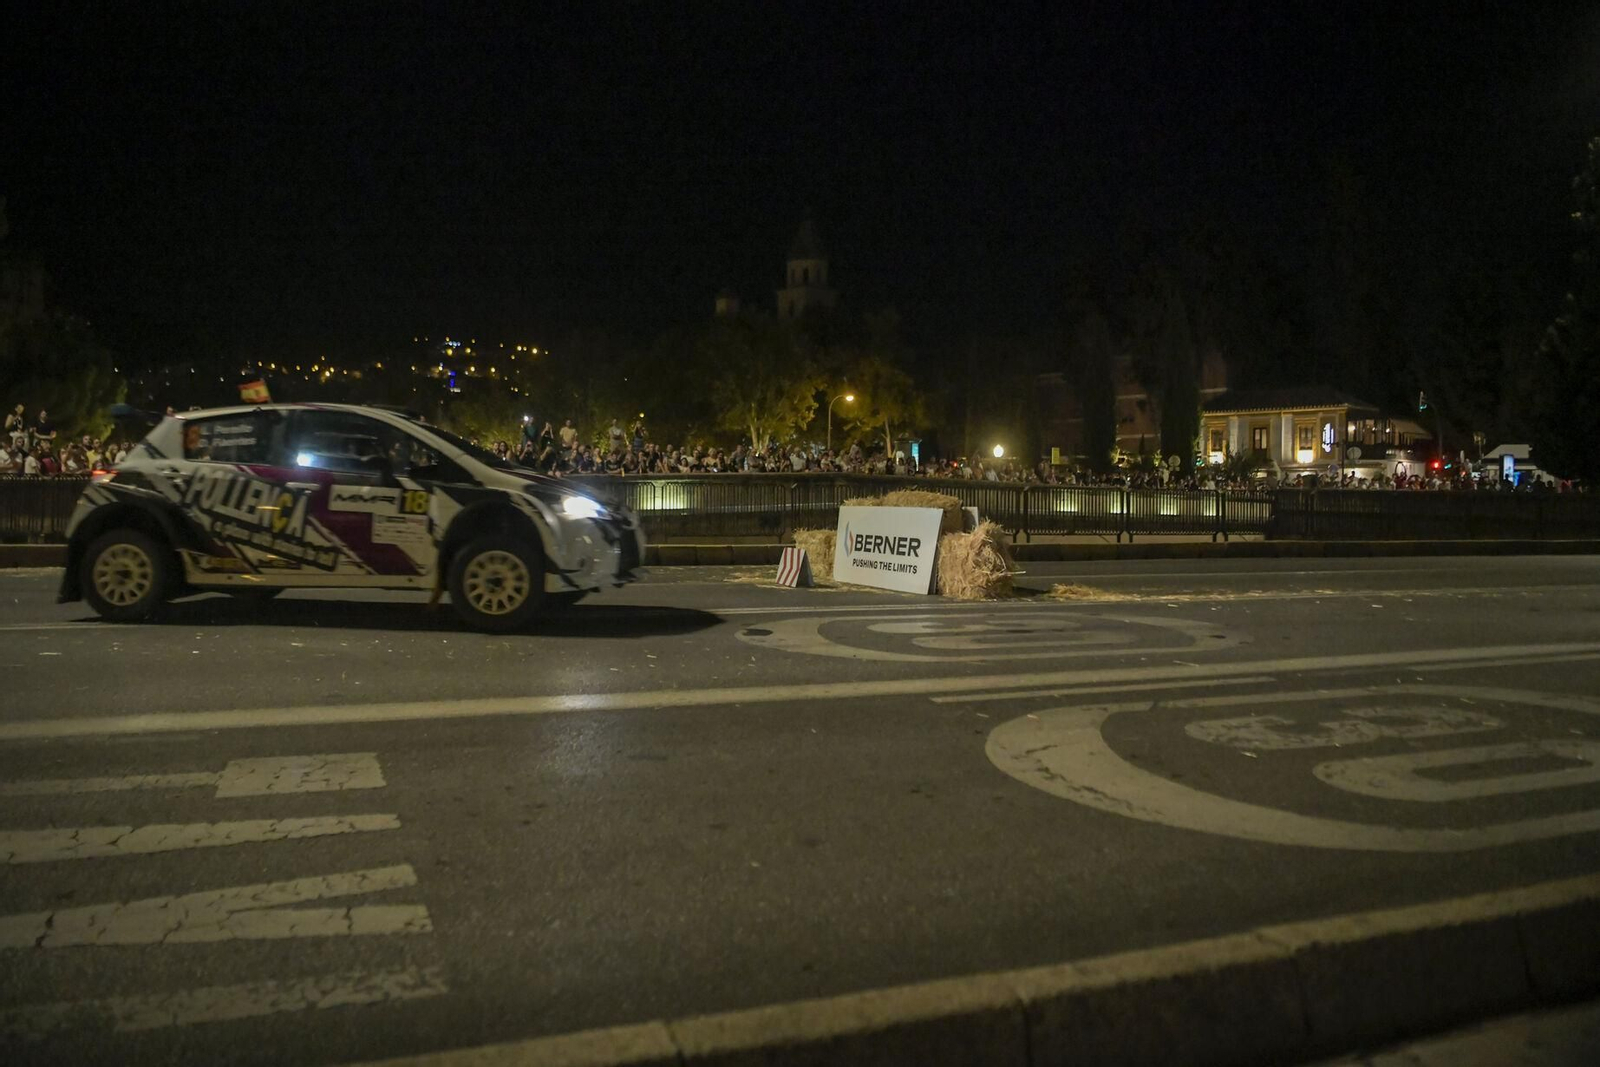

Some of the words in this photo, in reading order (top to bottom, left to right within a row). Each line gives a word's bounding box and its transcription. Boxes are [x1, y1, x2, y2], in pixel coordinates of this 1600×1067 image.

[403, 490, 429, 513] 18
[854, 534, 921, 558] BERNER
[852, 558, 878, 570] PUSHING
[878, 560, 892, 571] THE
[892, 562, 918, 574] LIMITS
